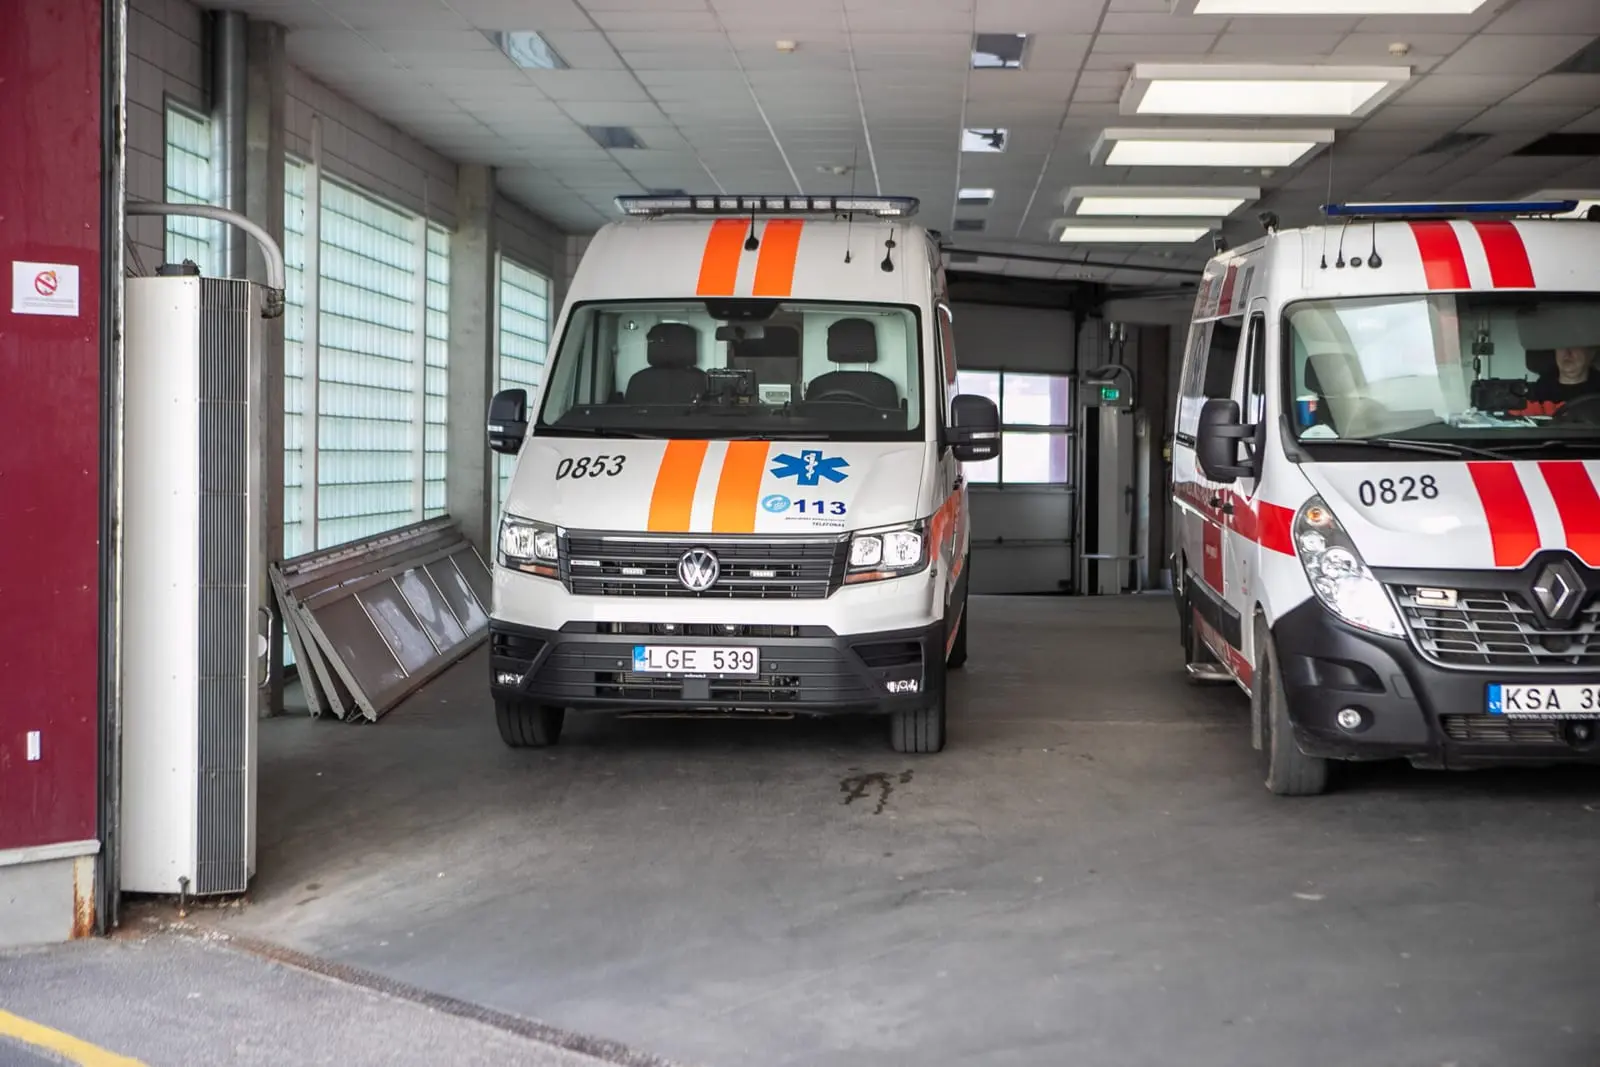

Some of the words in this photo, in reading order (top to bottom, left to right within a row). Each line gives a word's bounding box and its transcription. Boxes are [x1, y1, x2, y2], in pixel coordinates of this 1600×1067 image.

[555, 455, 627, 481] 0853
[1358, 474, 1439, 507] 0828
[793, 499, 847, 516] 113
[648, 649, 697, 669] LGE
[713, 650, 754, 671] 539
[1506, 687, 1561, 710] KSA
[1580, 687, 1600, 710] 3
